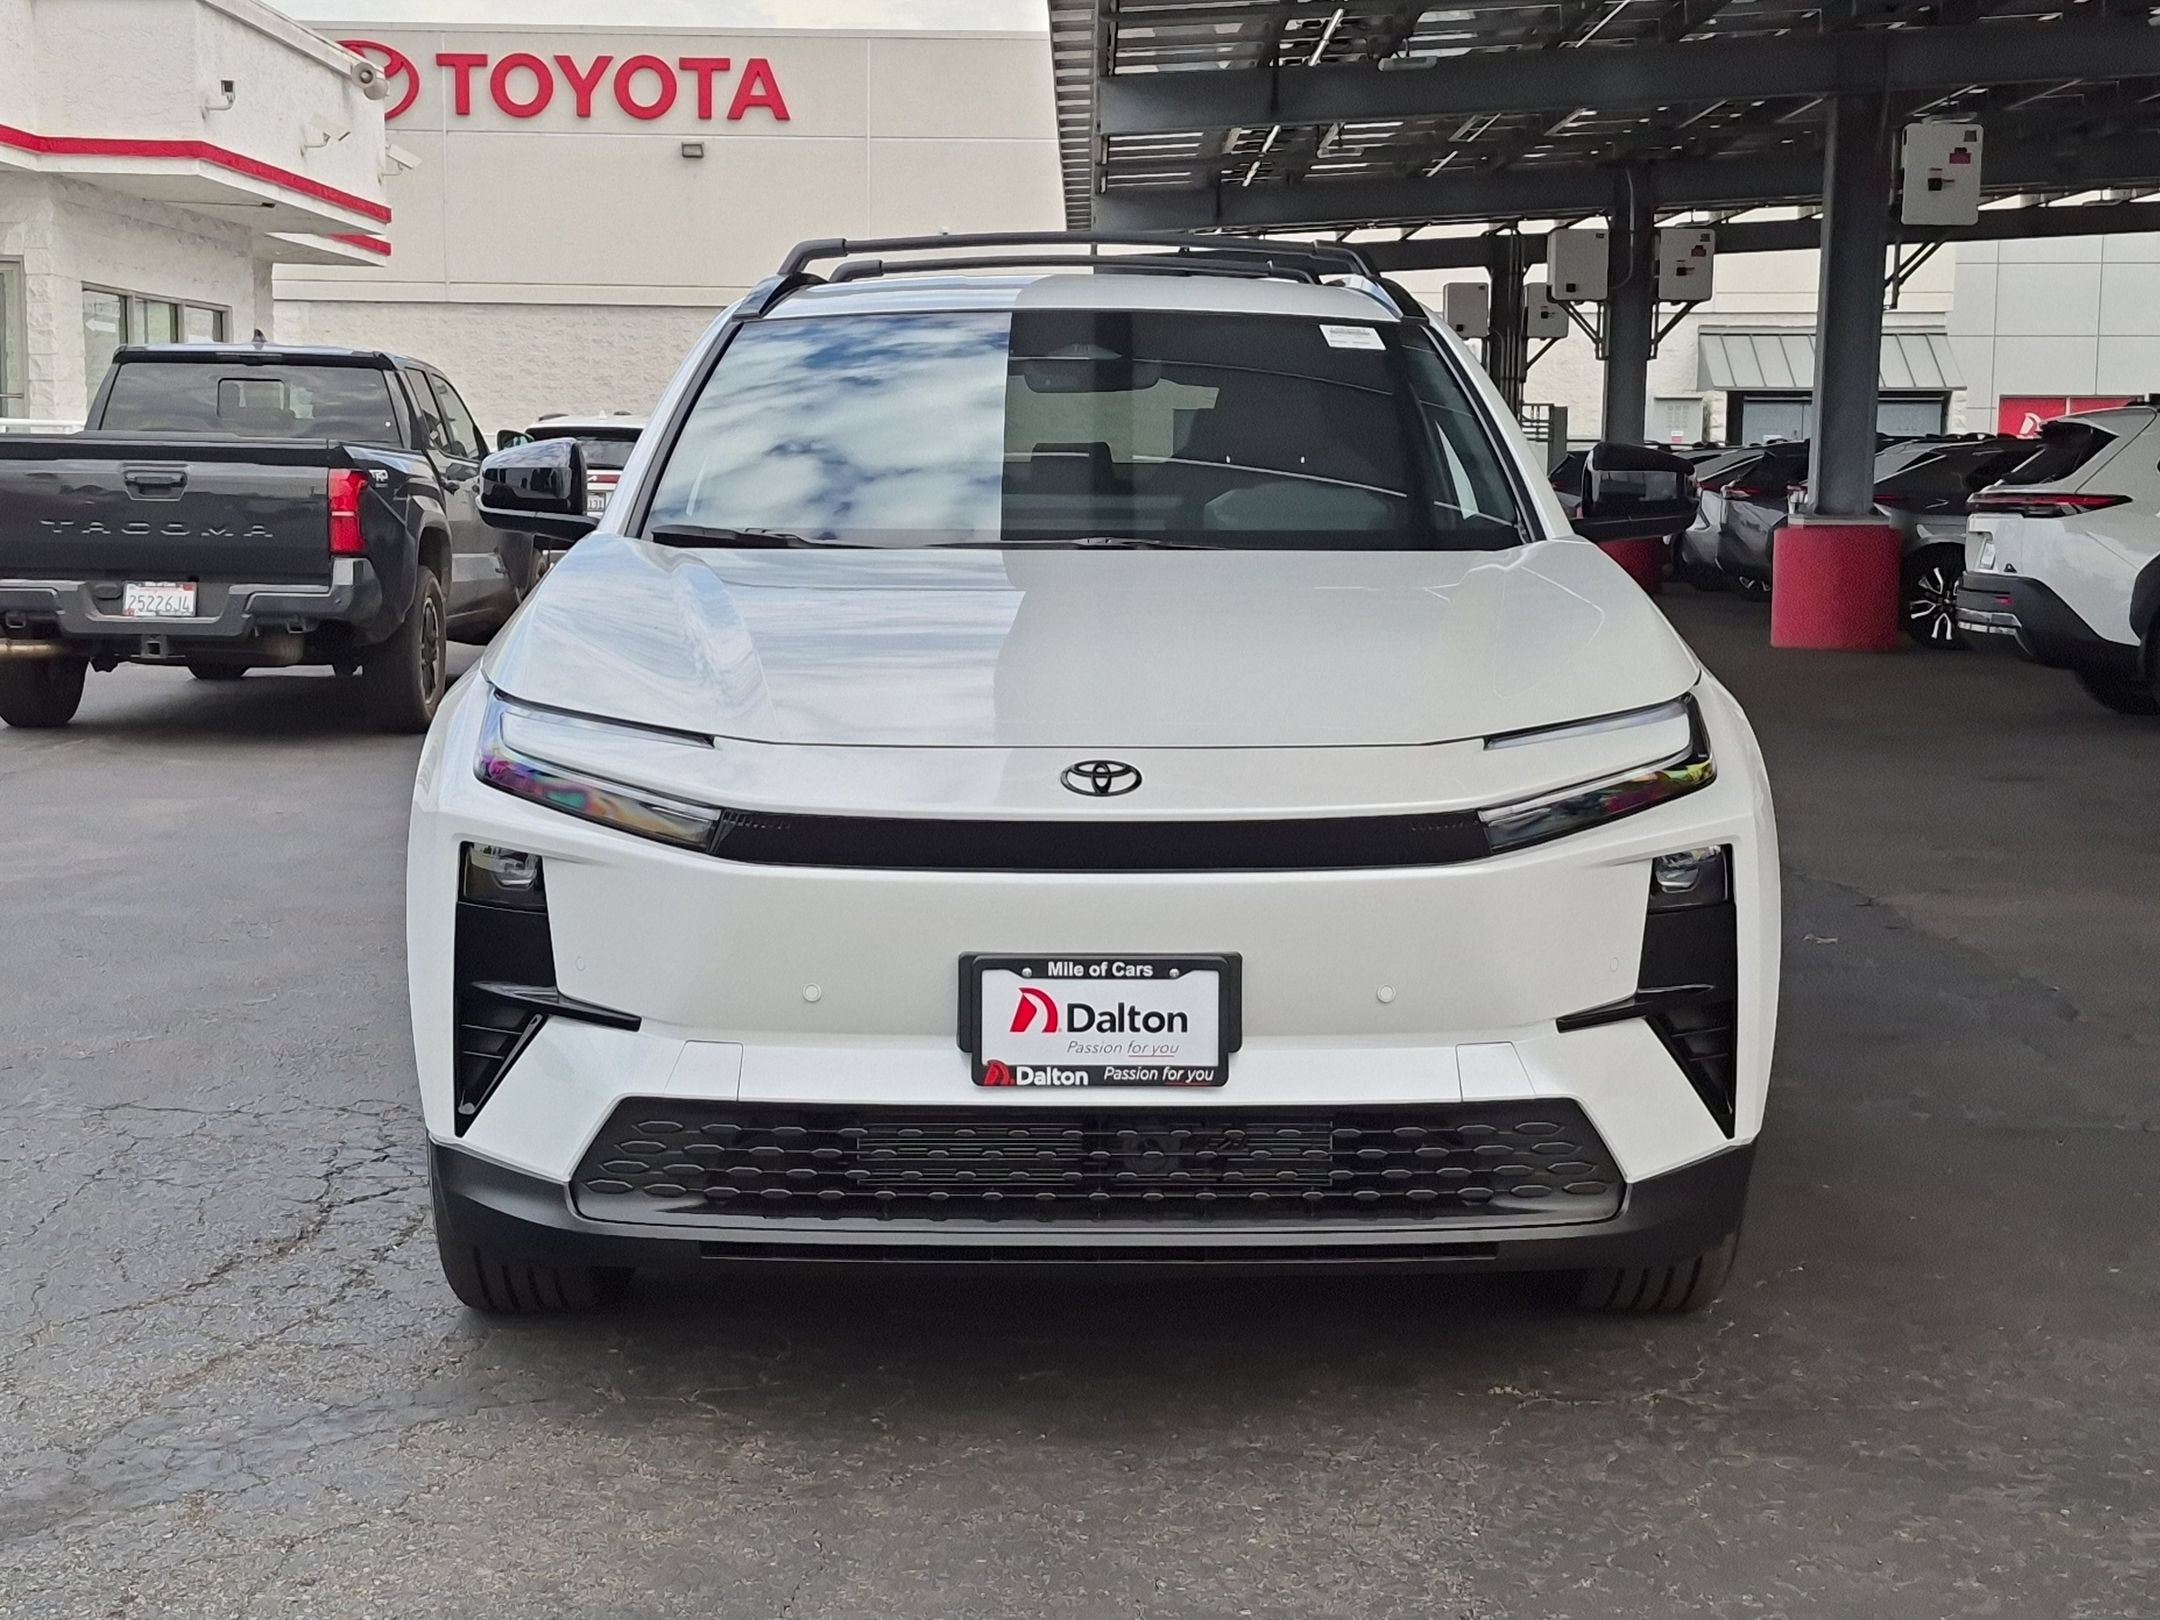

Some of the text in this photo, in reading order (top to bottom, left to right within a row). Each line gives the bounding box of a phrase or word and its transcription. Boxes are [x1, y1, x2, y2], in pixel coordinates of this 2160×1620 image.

[435, 52, 791, 122] TOYOTA
[40, 520, 274, 538] TACOMA
[1047, 961, 1154, 977] Mile of Cars
[1066, 1002, 1188, 1033] Dalton
[1066, 1040, 1180, 1056] Passion for you
[1015, 1066, 1089, 1086] Dalton
[1103, 1066, 1214, 1084] Passion for you
